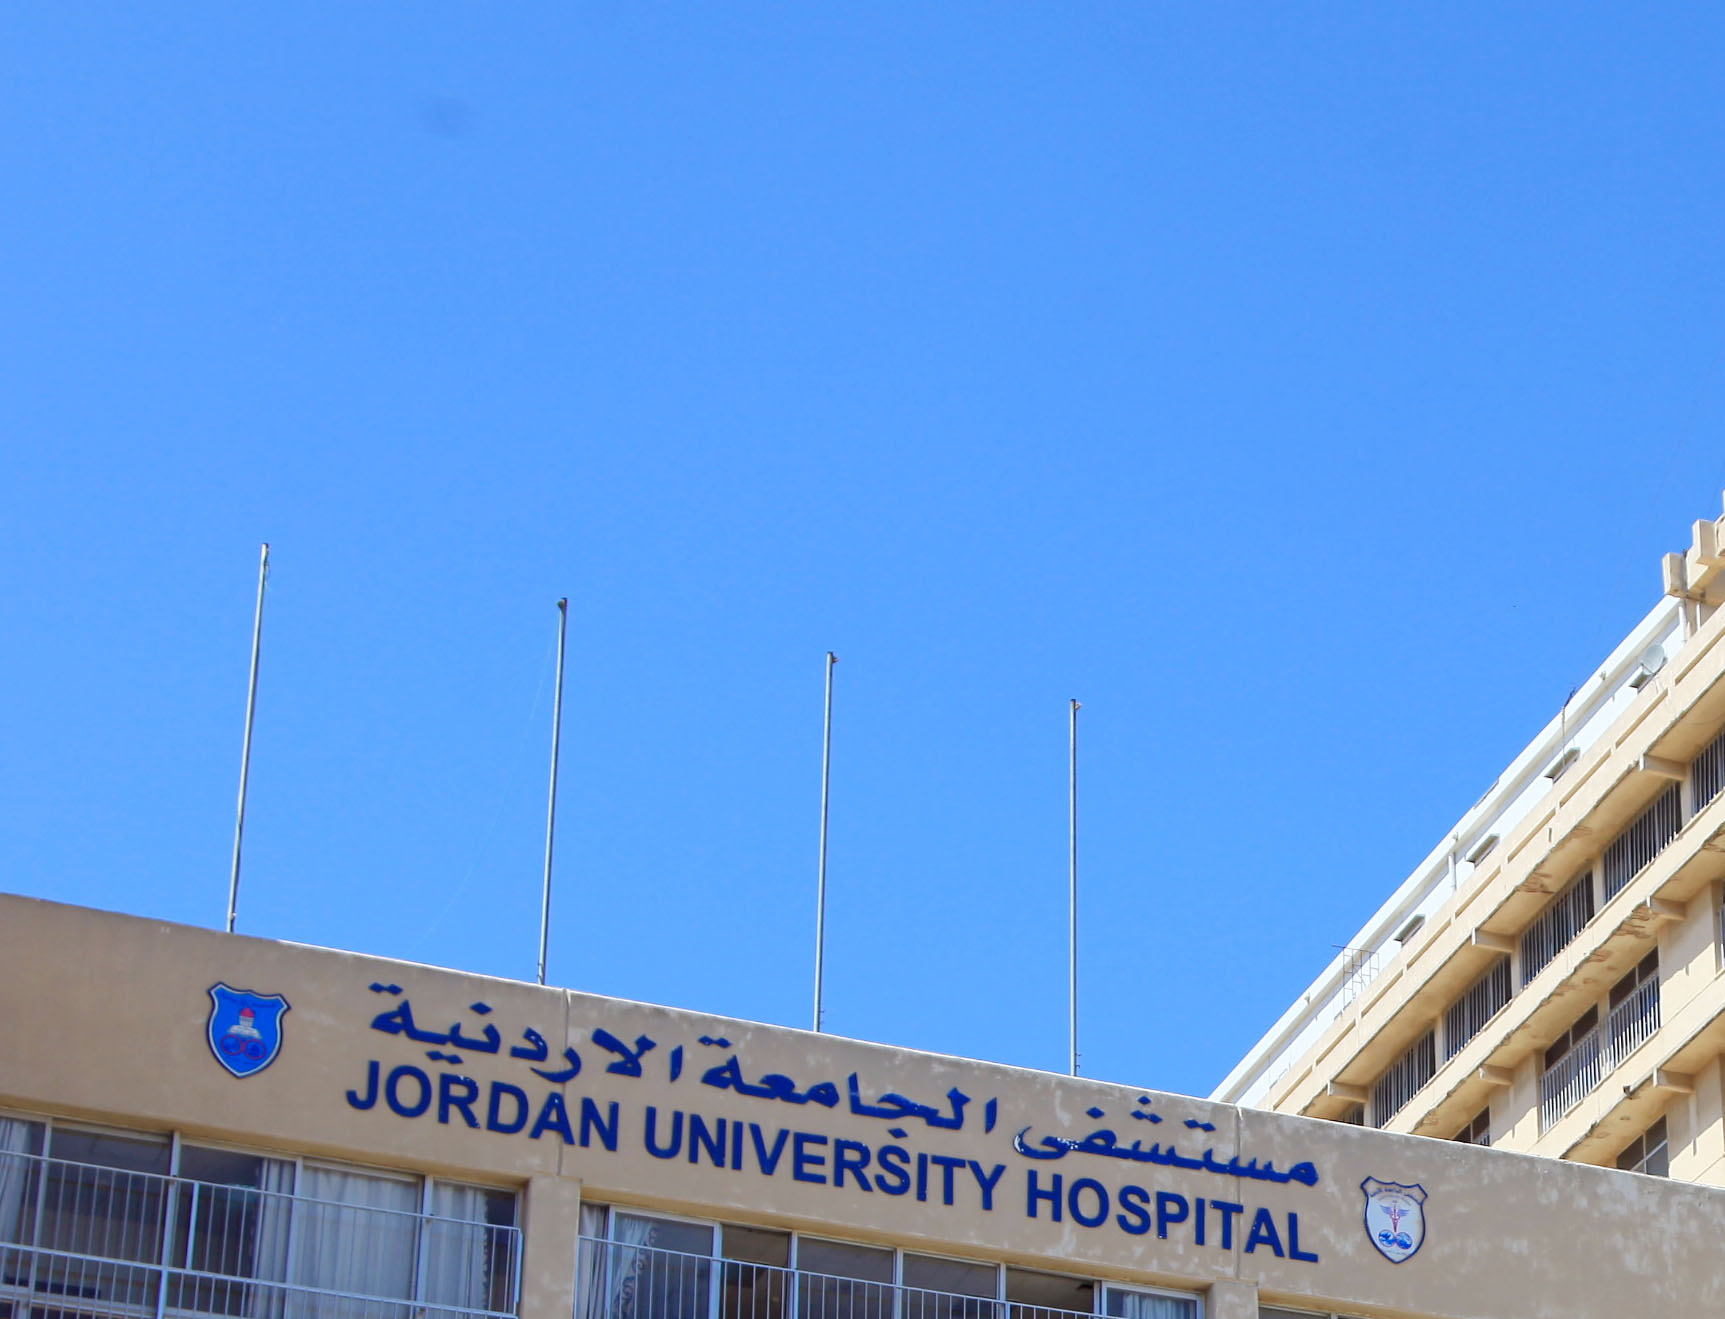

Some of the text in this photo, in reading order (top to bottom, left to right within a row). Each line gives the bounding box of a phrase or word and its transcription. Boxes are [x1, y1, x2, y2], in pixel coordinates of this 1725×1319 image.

[346, 1059, 1320, 1264] JORDAN UNIVERSITY HOSPITAL
[368, 981, 1321, 1188] مستشفى الجامعة الاردنية
